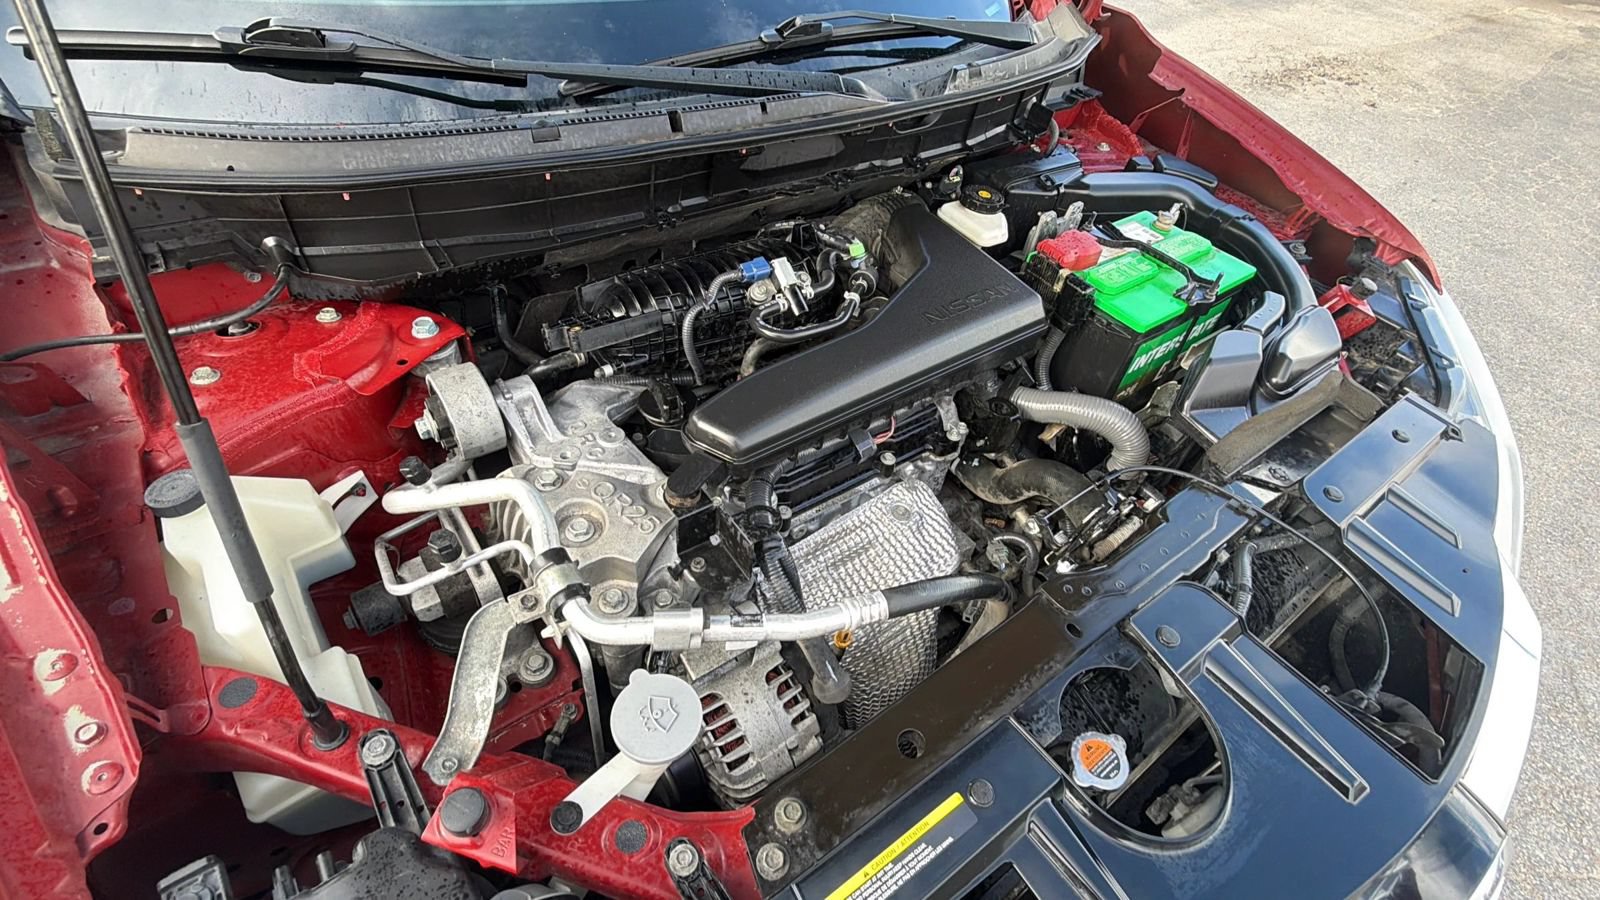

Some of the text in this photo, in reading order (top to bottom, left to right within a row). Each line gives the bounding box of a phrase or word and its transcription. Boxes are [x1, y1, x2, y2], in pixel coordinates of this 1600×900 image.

[921, 283, 1016, 325] NISSAN
[591, 480, 663, 534] QR25
[491, 827, 513, 858] BAR
[871, 849, 897, 870] CAUTION
[901, 821, 929, 847] ATTENTION
